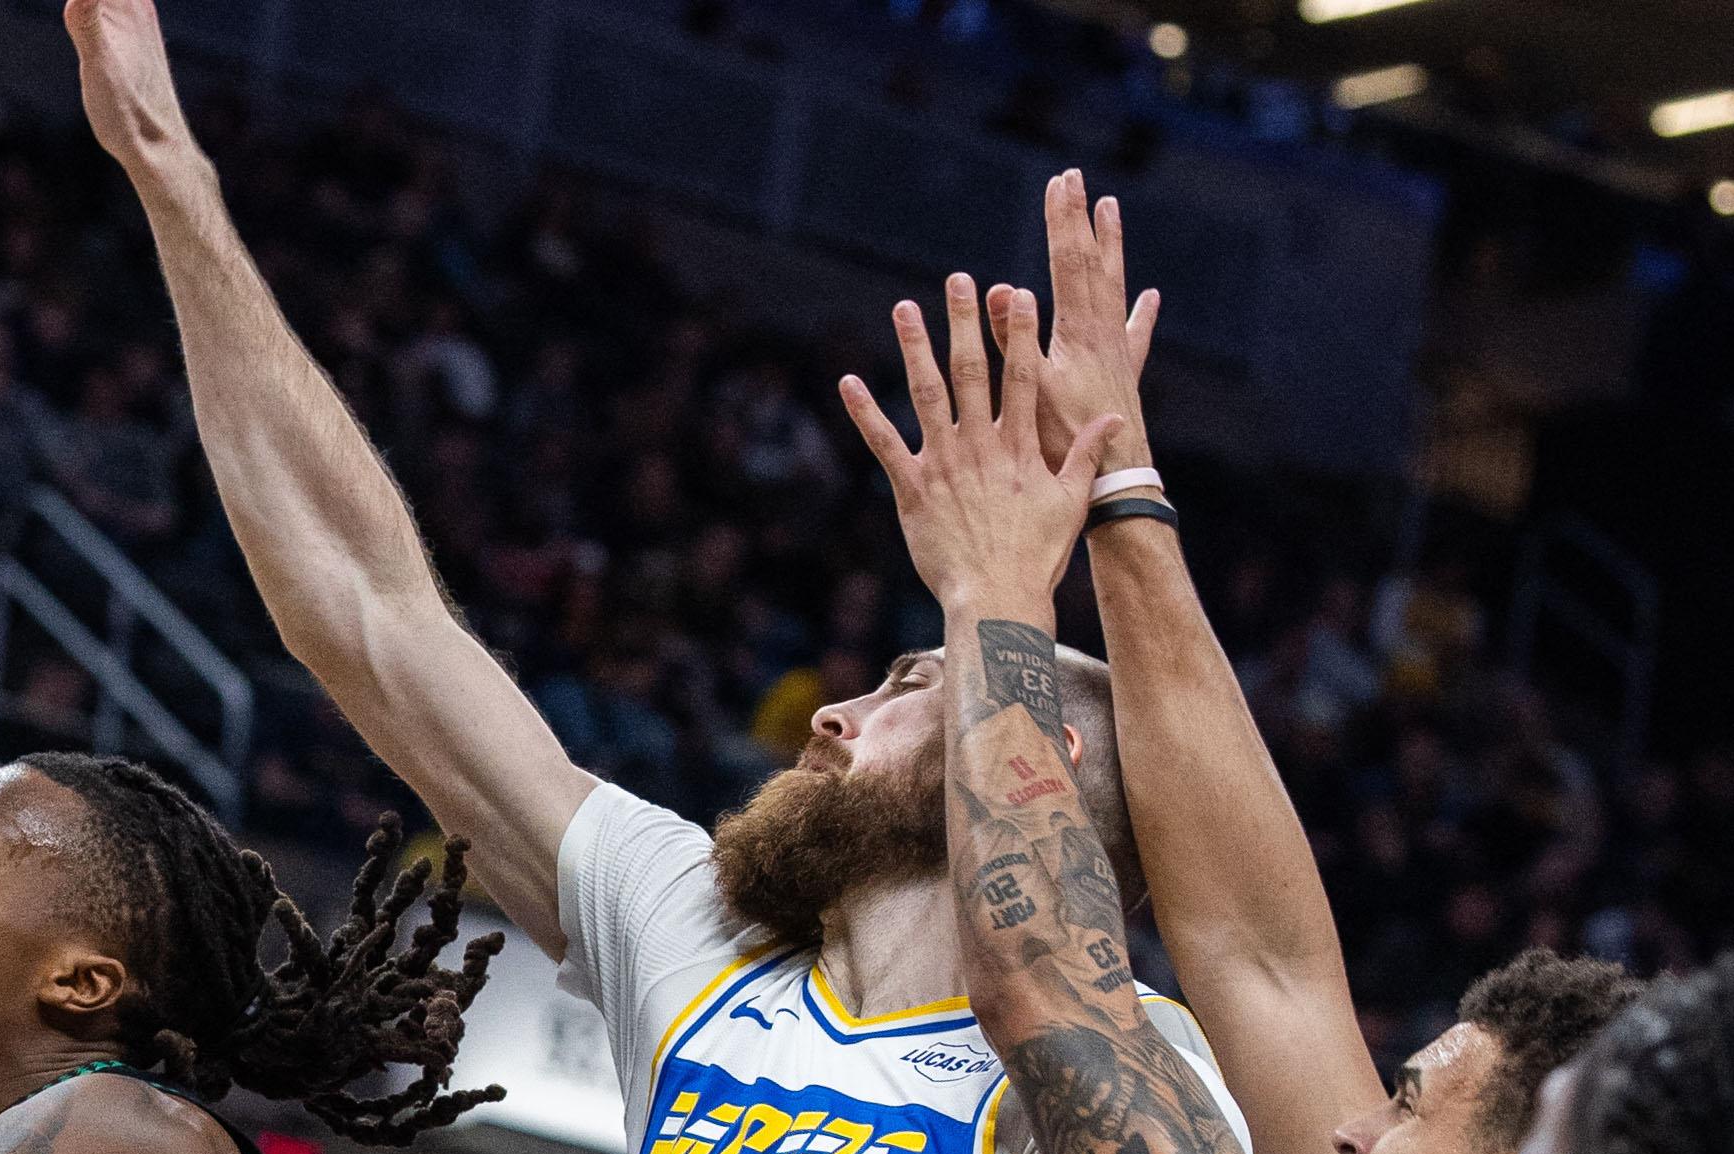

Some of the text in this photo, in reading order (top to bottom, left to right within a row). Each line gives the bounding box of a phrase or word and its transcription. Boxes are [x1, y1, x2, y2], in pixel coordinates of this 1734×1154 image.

[1021, 668, 1054, 698] 33
[899, 1049, 998, 1074] LUCAS OIL
